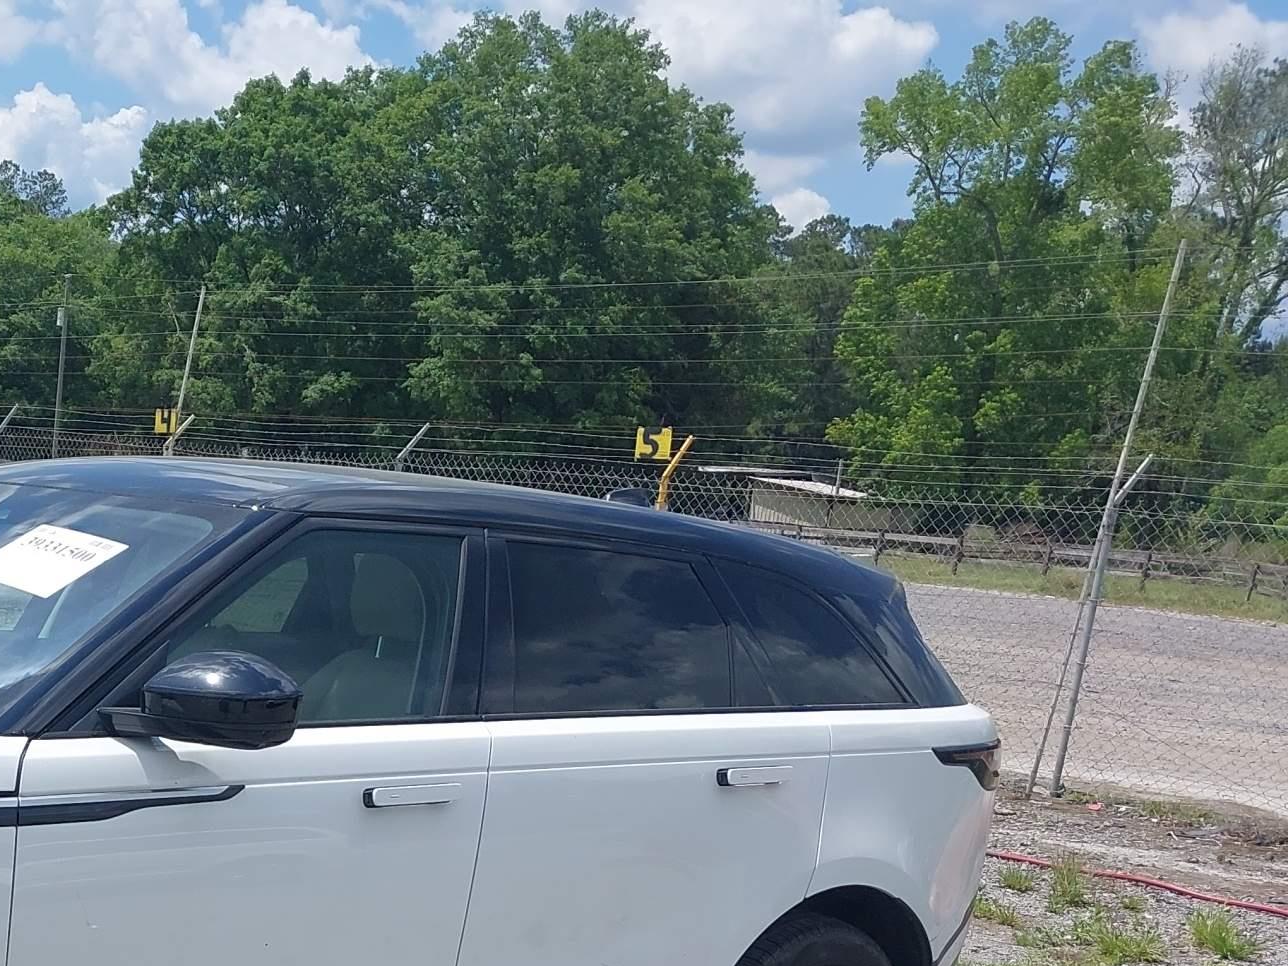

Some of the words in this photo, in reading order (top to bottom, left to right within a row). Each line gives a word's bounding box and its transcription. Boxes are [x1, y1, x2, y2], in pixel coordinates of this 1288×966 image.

[160, 408, 171, 433] 4
[638, 426, 662, 458] 5
[20, 536, 97, 562] 39331500
